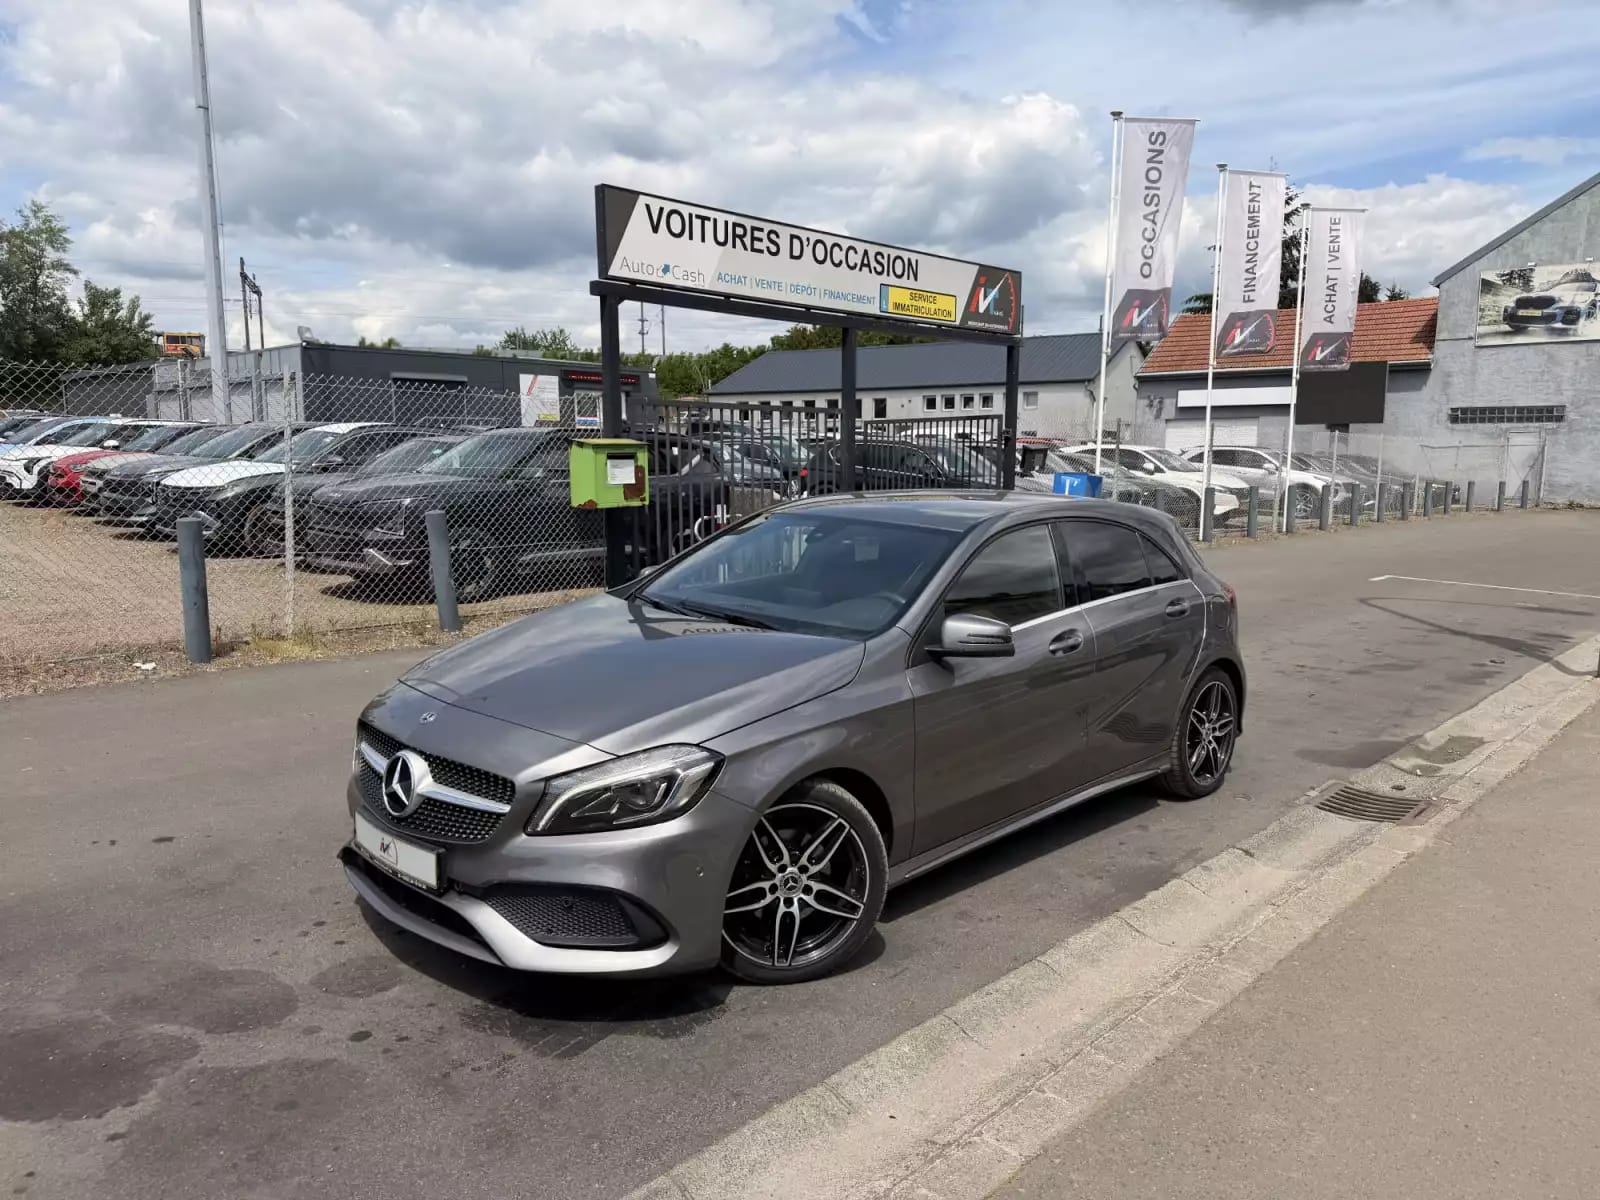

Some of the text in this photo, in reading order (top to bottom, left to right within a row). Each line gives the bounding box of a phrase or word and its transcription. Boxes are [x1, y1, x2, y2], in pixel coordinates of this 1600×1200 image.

[1140, 130, 1167, 279] OCCASIONS
[644, 203, 781, 257] VOITURES
[1243, 181, 1262, 304] FINANCEMENT
[619, 256, 705, 284] Auto Cash
[717, 271, 748, 287] ACHAT
[755, 278, 784, 292] VENTE
[823, 289, 877, 306] FINANCEMENT
[1322, 216, 1342, 325] ACHAT VENTE
[892, 302, 952, 318] IMMATRICULATION
[909, 291, 937, 305] SERVICE
